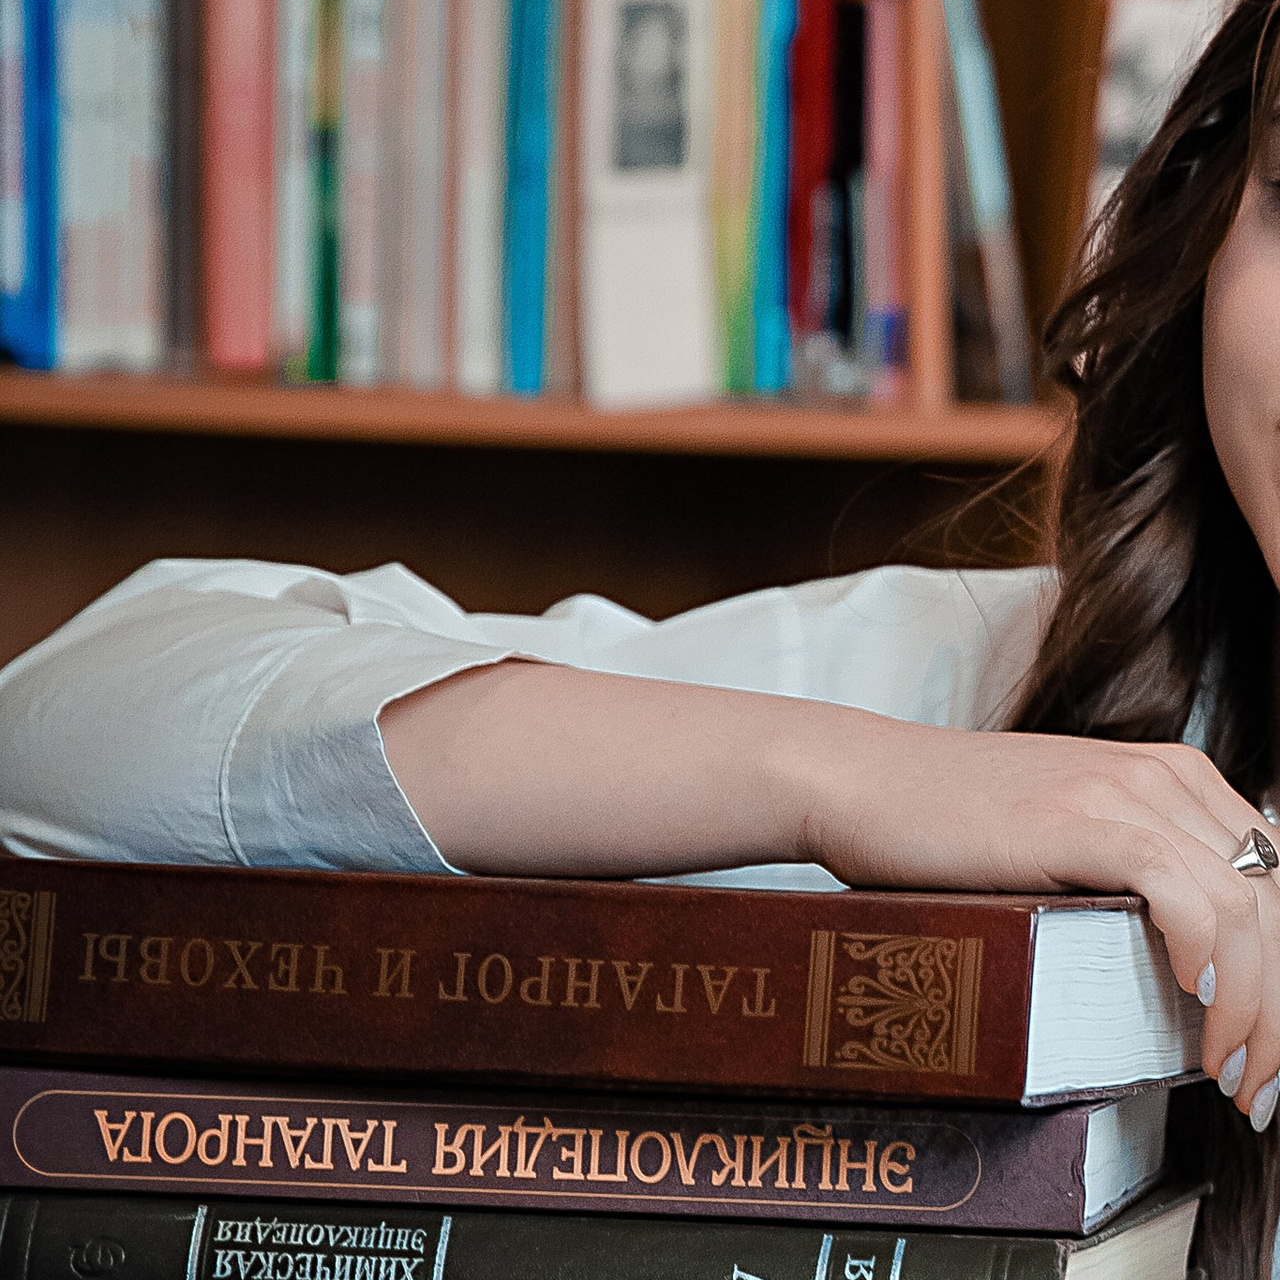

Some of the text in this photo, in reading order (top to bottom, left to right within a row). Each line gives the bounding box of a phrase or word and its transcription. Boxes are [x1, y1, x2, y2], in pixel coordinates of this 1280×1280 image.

[78, 932, 777, 1018] ТАГАНРОГ И ЧЕХОВЫ
[95, 1110, 915, 1193] ЭНЦИКЛОПЕДИЯ ТАГАНРОГА
[214, 1217, 428, 1252] ЭНЦИКЛОПЕДИЯ
